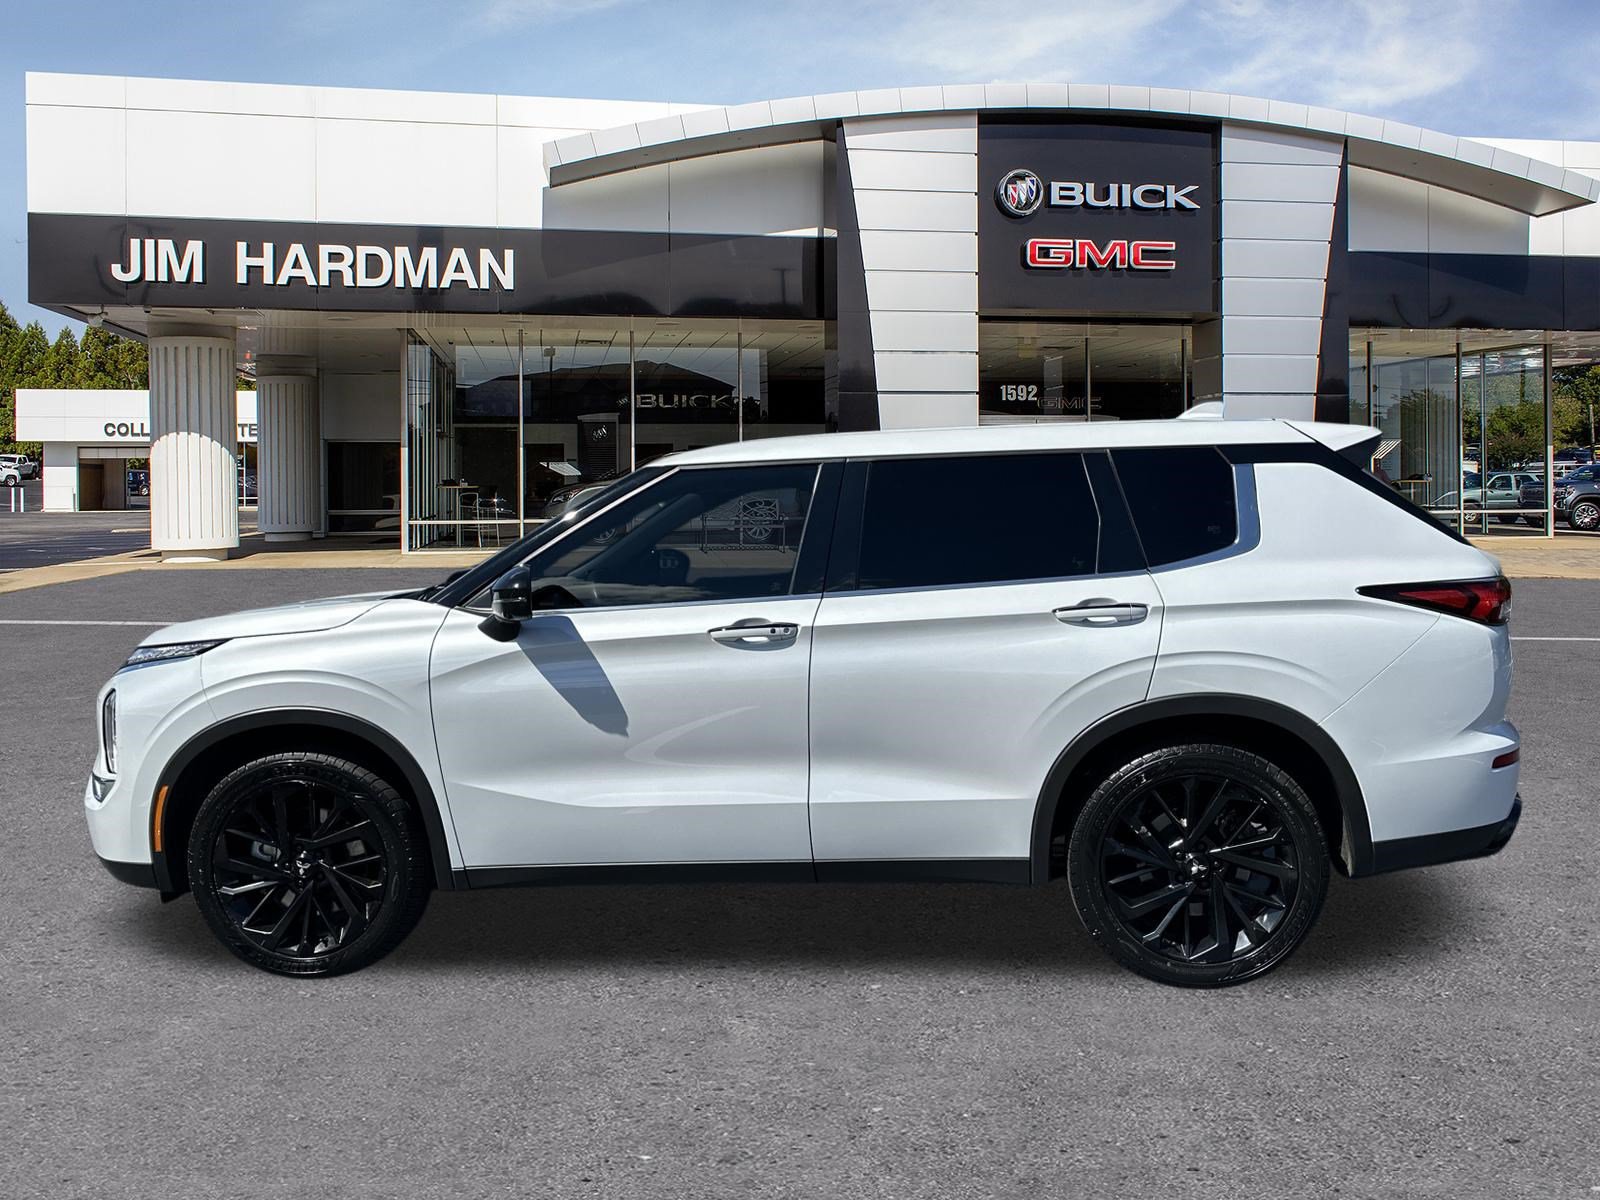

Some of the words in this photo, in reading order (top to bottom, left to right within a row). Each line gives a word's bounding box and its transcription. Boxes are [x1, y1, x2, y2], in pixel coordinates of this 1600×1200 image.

[1050, 181, 1200, 209] BUICK
[111, 238, 204, 284] JIM
[236, 240, 516, 291] HARDMAN
[1026, 238, 1176, 269] GMC
[636, 393, 731, 409] BUICK
[1000, 384, 1038, 401] 1592
[1037, 396, 1102, 409] GMC
